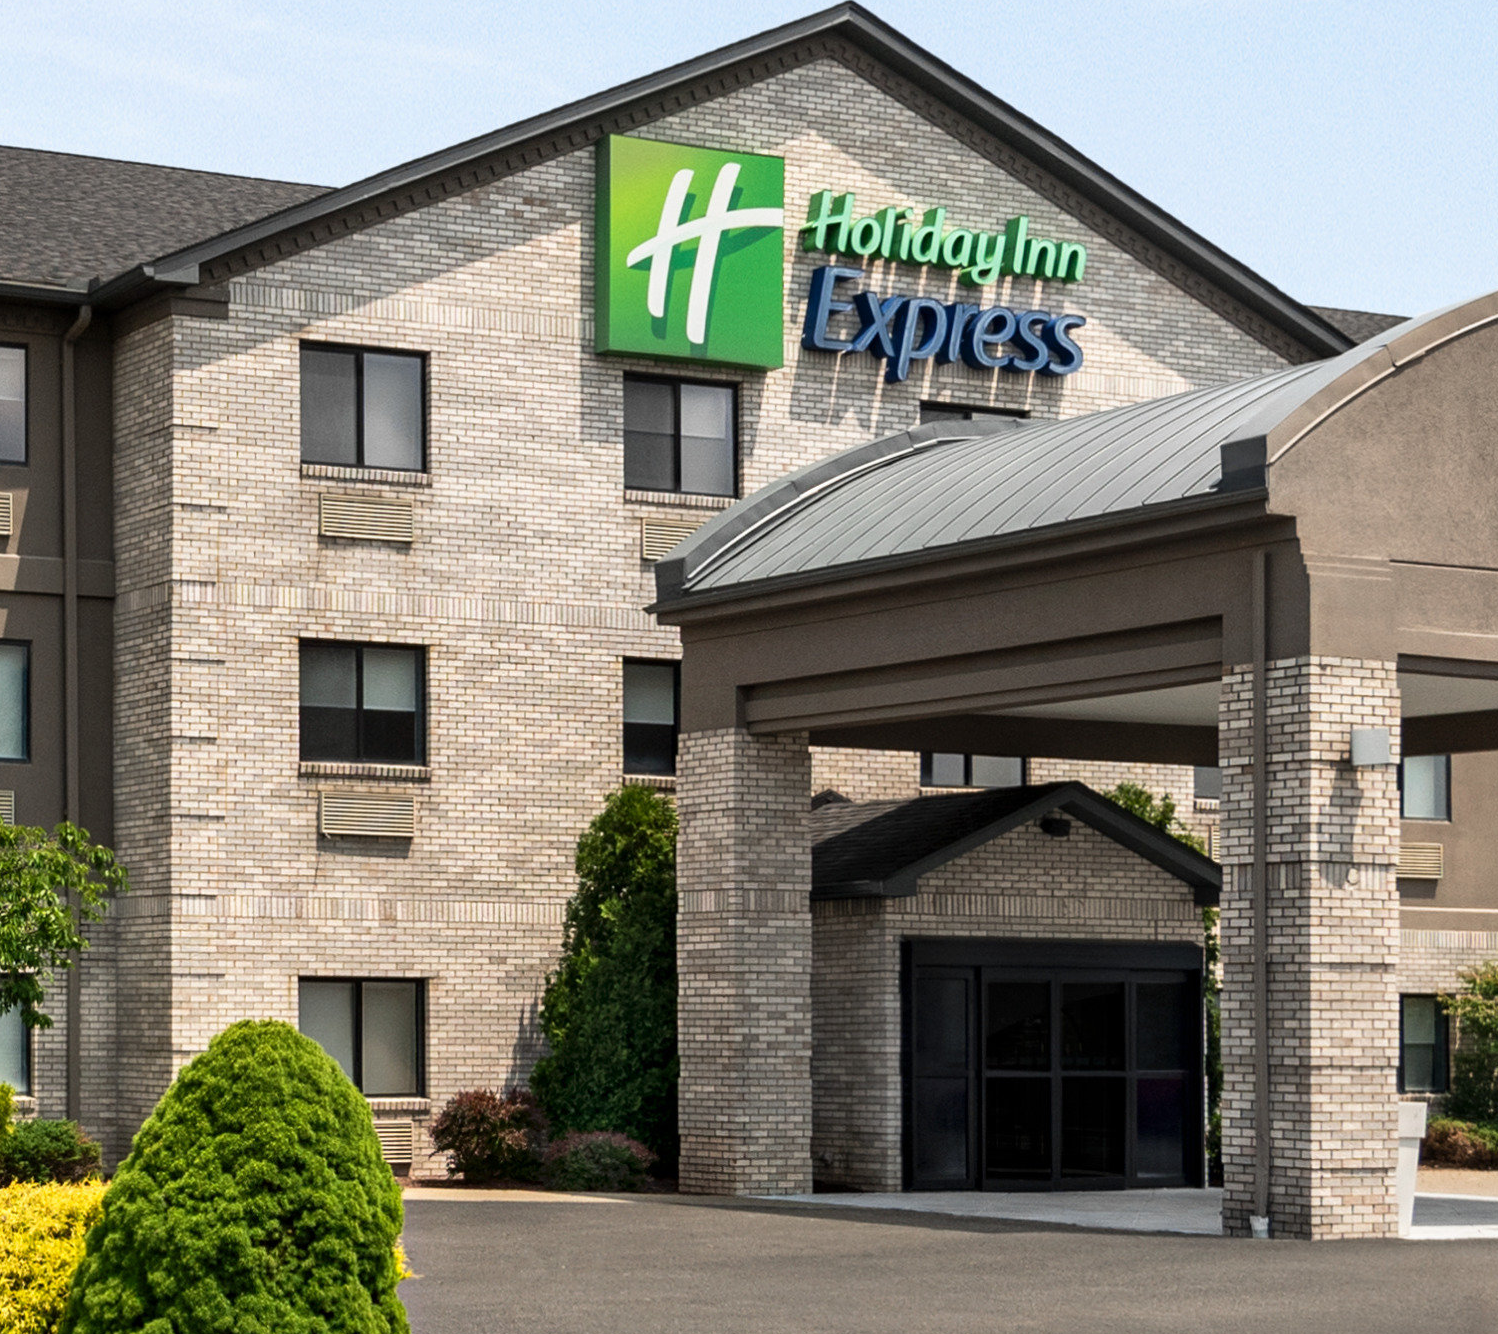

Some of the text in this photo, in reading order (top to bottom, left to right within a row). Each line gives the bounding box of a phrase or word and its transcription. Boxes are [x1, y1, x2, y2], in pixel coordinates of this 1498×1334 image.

[801, 189, 1087, 285] Holiday Inn
[802, 265, 1087, 382] Express
